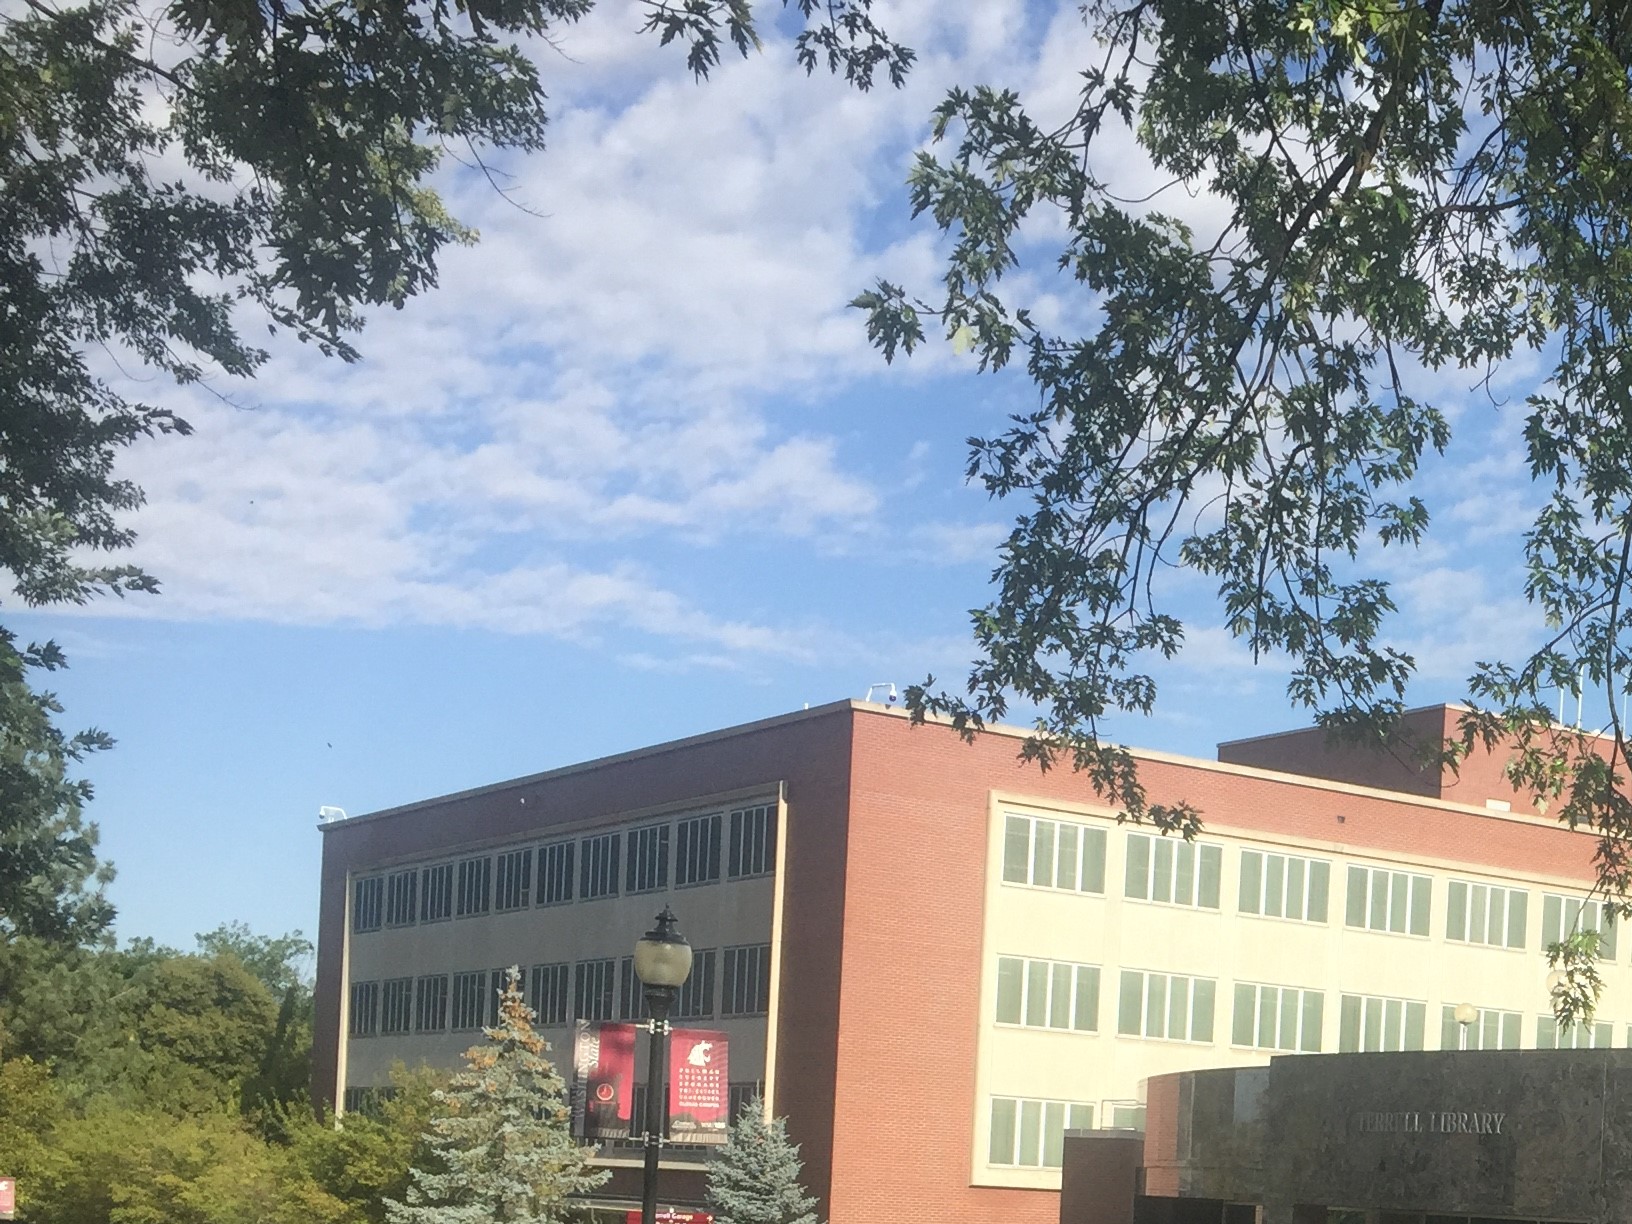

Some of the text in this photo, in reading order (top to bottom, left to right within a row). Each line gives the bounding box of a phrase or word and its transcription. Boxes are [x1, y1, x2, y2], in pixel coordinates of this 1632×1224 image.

[588, 1036, 600, 1069] State
[1429, 1112, 1506, 1134] LIBRARY
[671, 1213, 693, 1221] Garage
